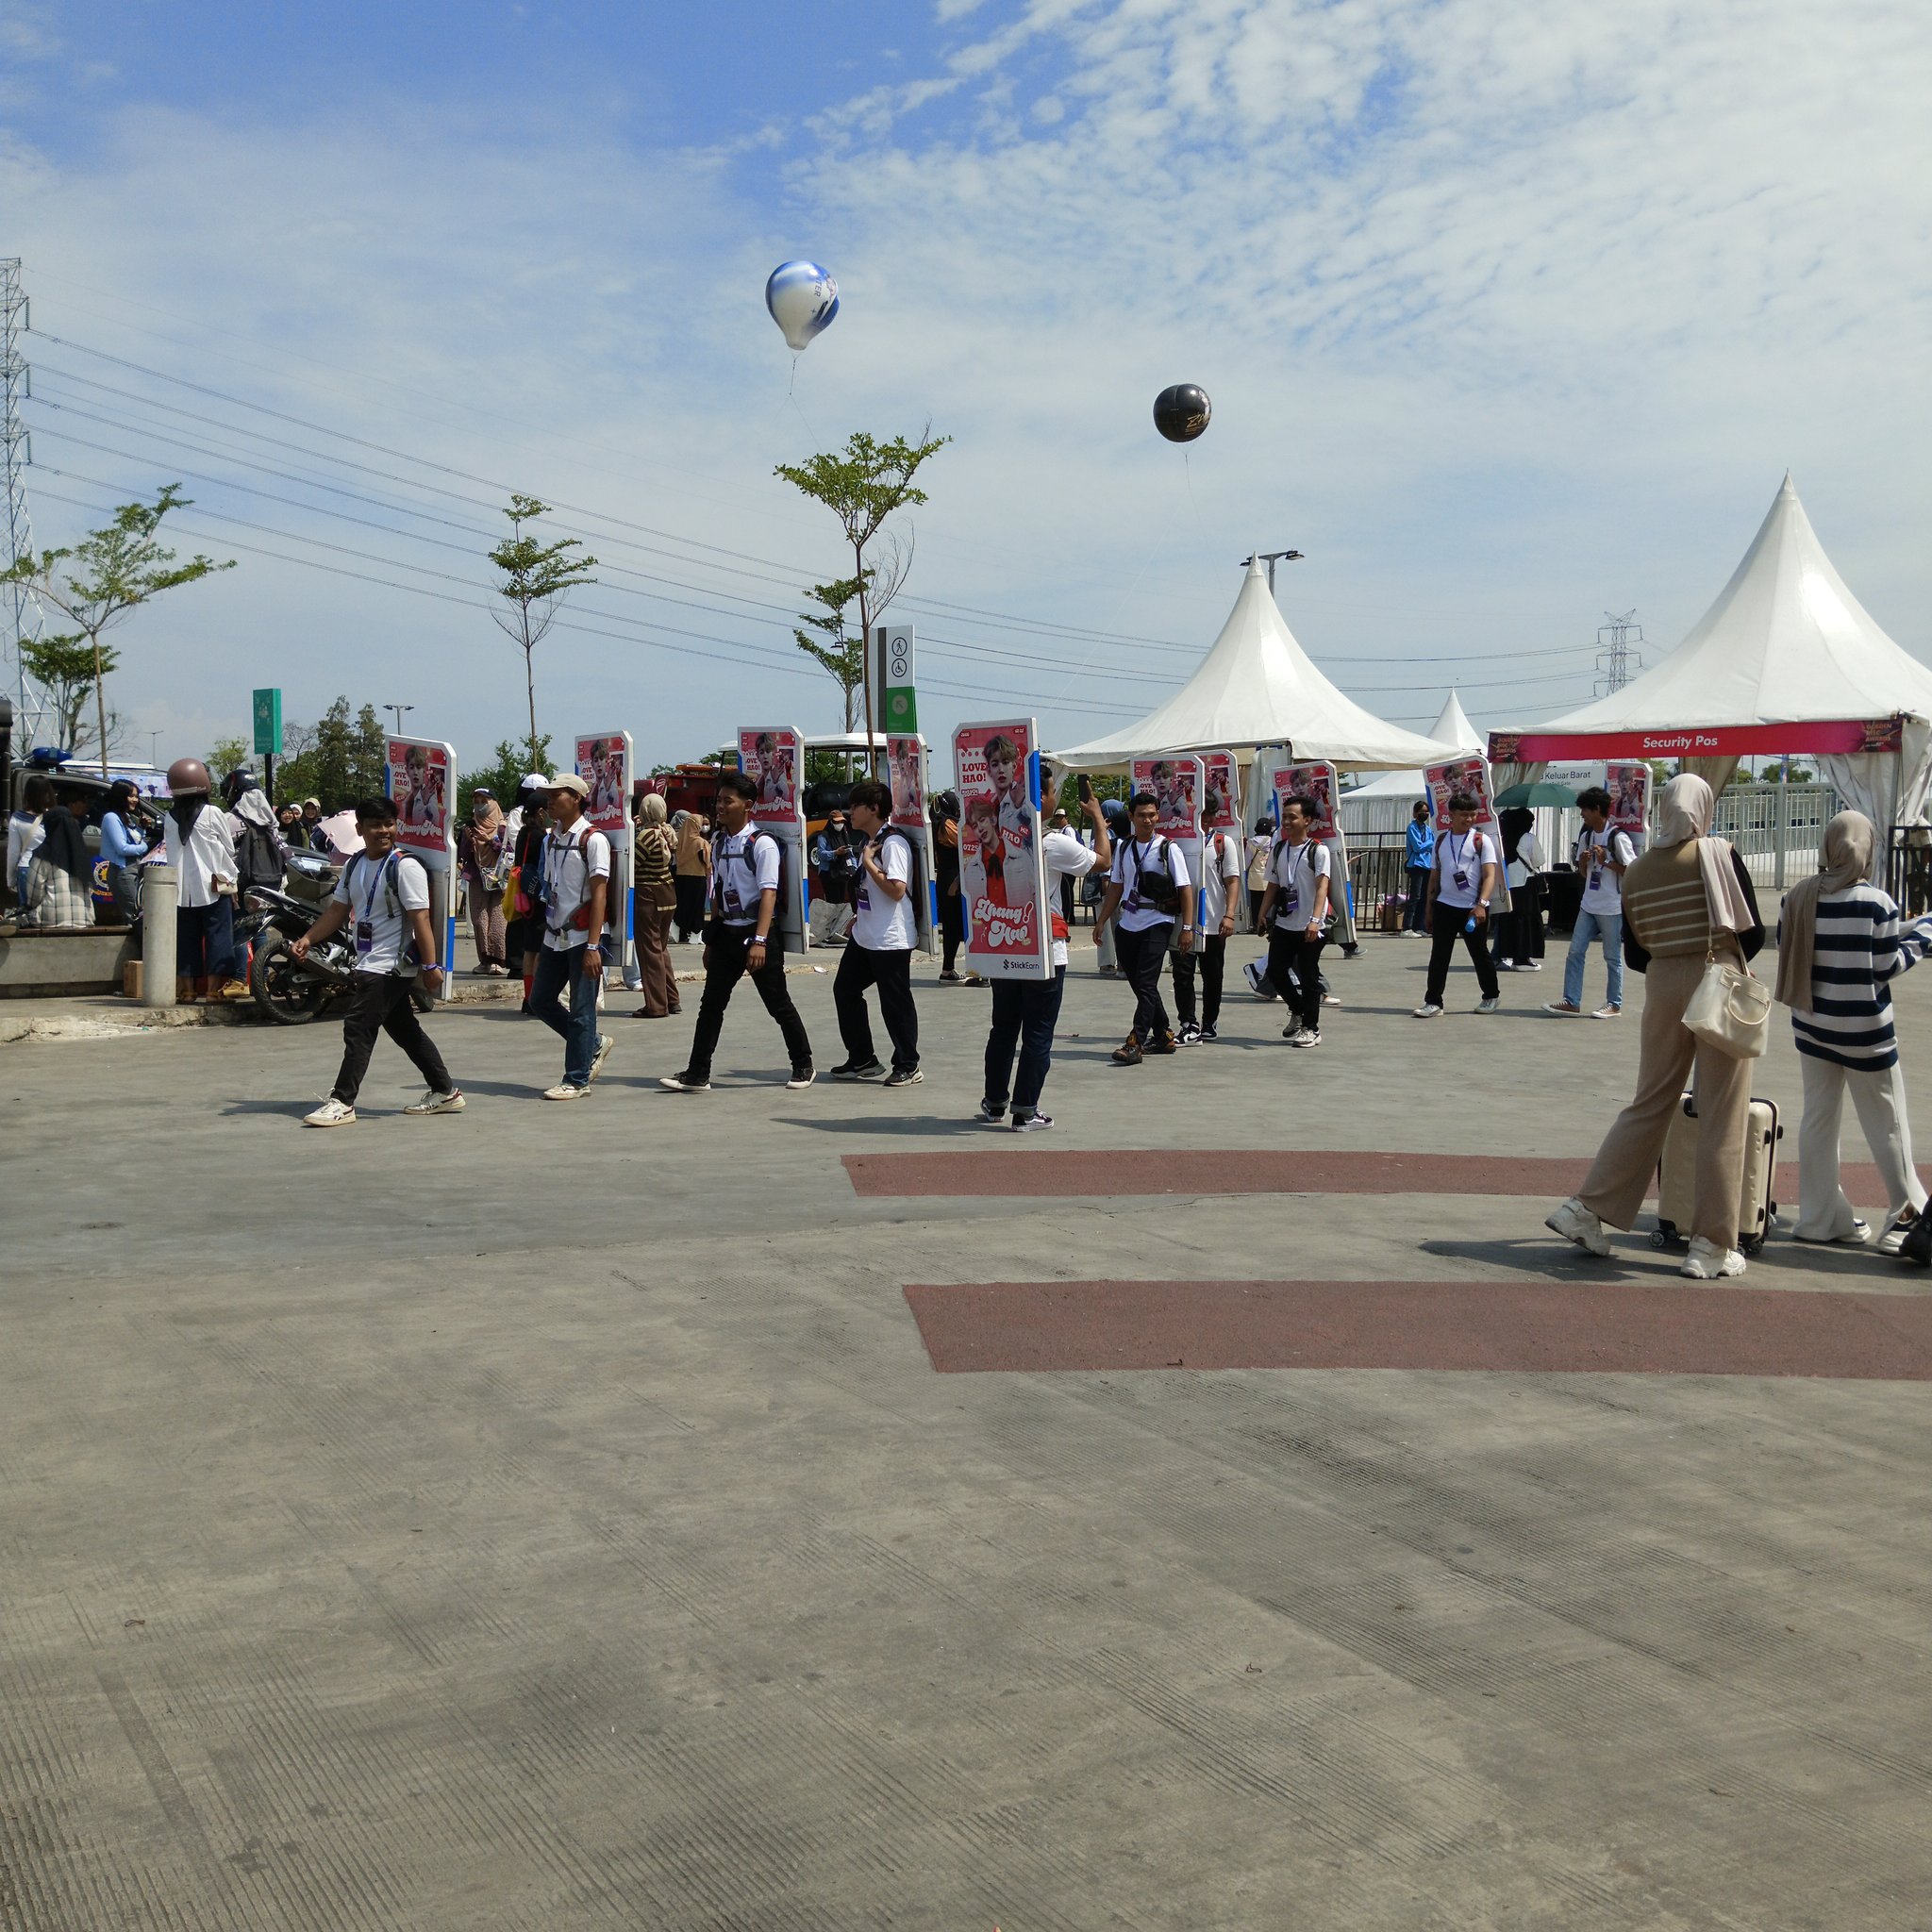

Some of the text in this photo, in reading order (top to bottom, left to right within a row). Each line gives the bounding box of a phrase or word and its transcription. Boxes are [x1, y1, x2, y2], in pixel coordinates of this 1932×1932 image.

[1643, 735, 1718, 750] Security Pos
[962, 762, 987, 772] LOVE
[962, 774, 987, 783] HAO!
[1545, 772, 1569, 780] Keluar
[1570, 771, 1591, 779] Barat
[1002, 829, 1021, 844] HAO
[988, 920, 1028, 947] Hao
[1010, 961, 1040, 970] StickEarn
